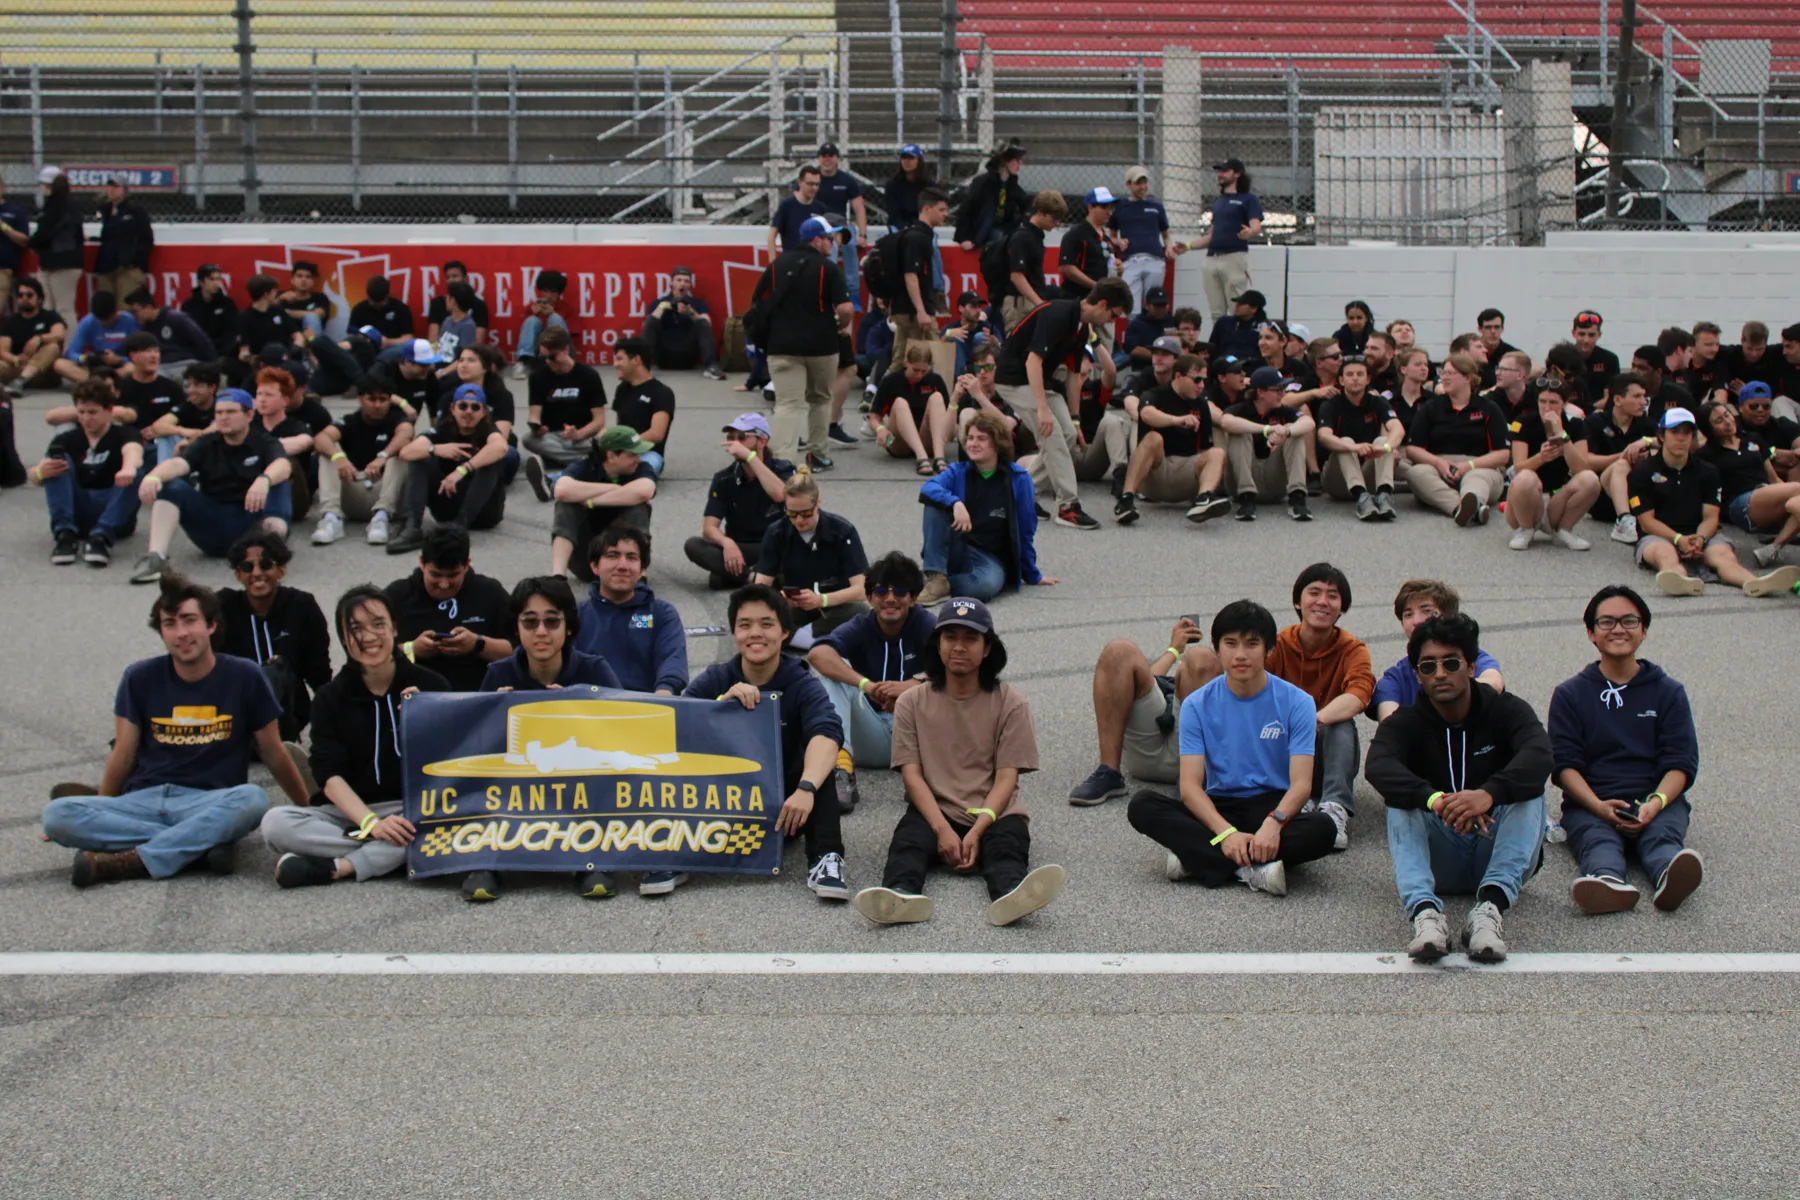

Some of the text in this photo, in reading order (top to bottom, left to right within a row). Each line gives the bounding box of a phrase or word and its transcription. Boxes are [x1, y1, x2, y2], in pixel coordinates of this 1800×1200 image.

[67, 170, 162, 186] SECTN 2
[953, 601, 976, 610] UCSB
[420, 782, 765, 817] UC SANTA BARBARA
